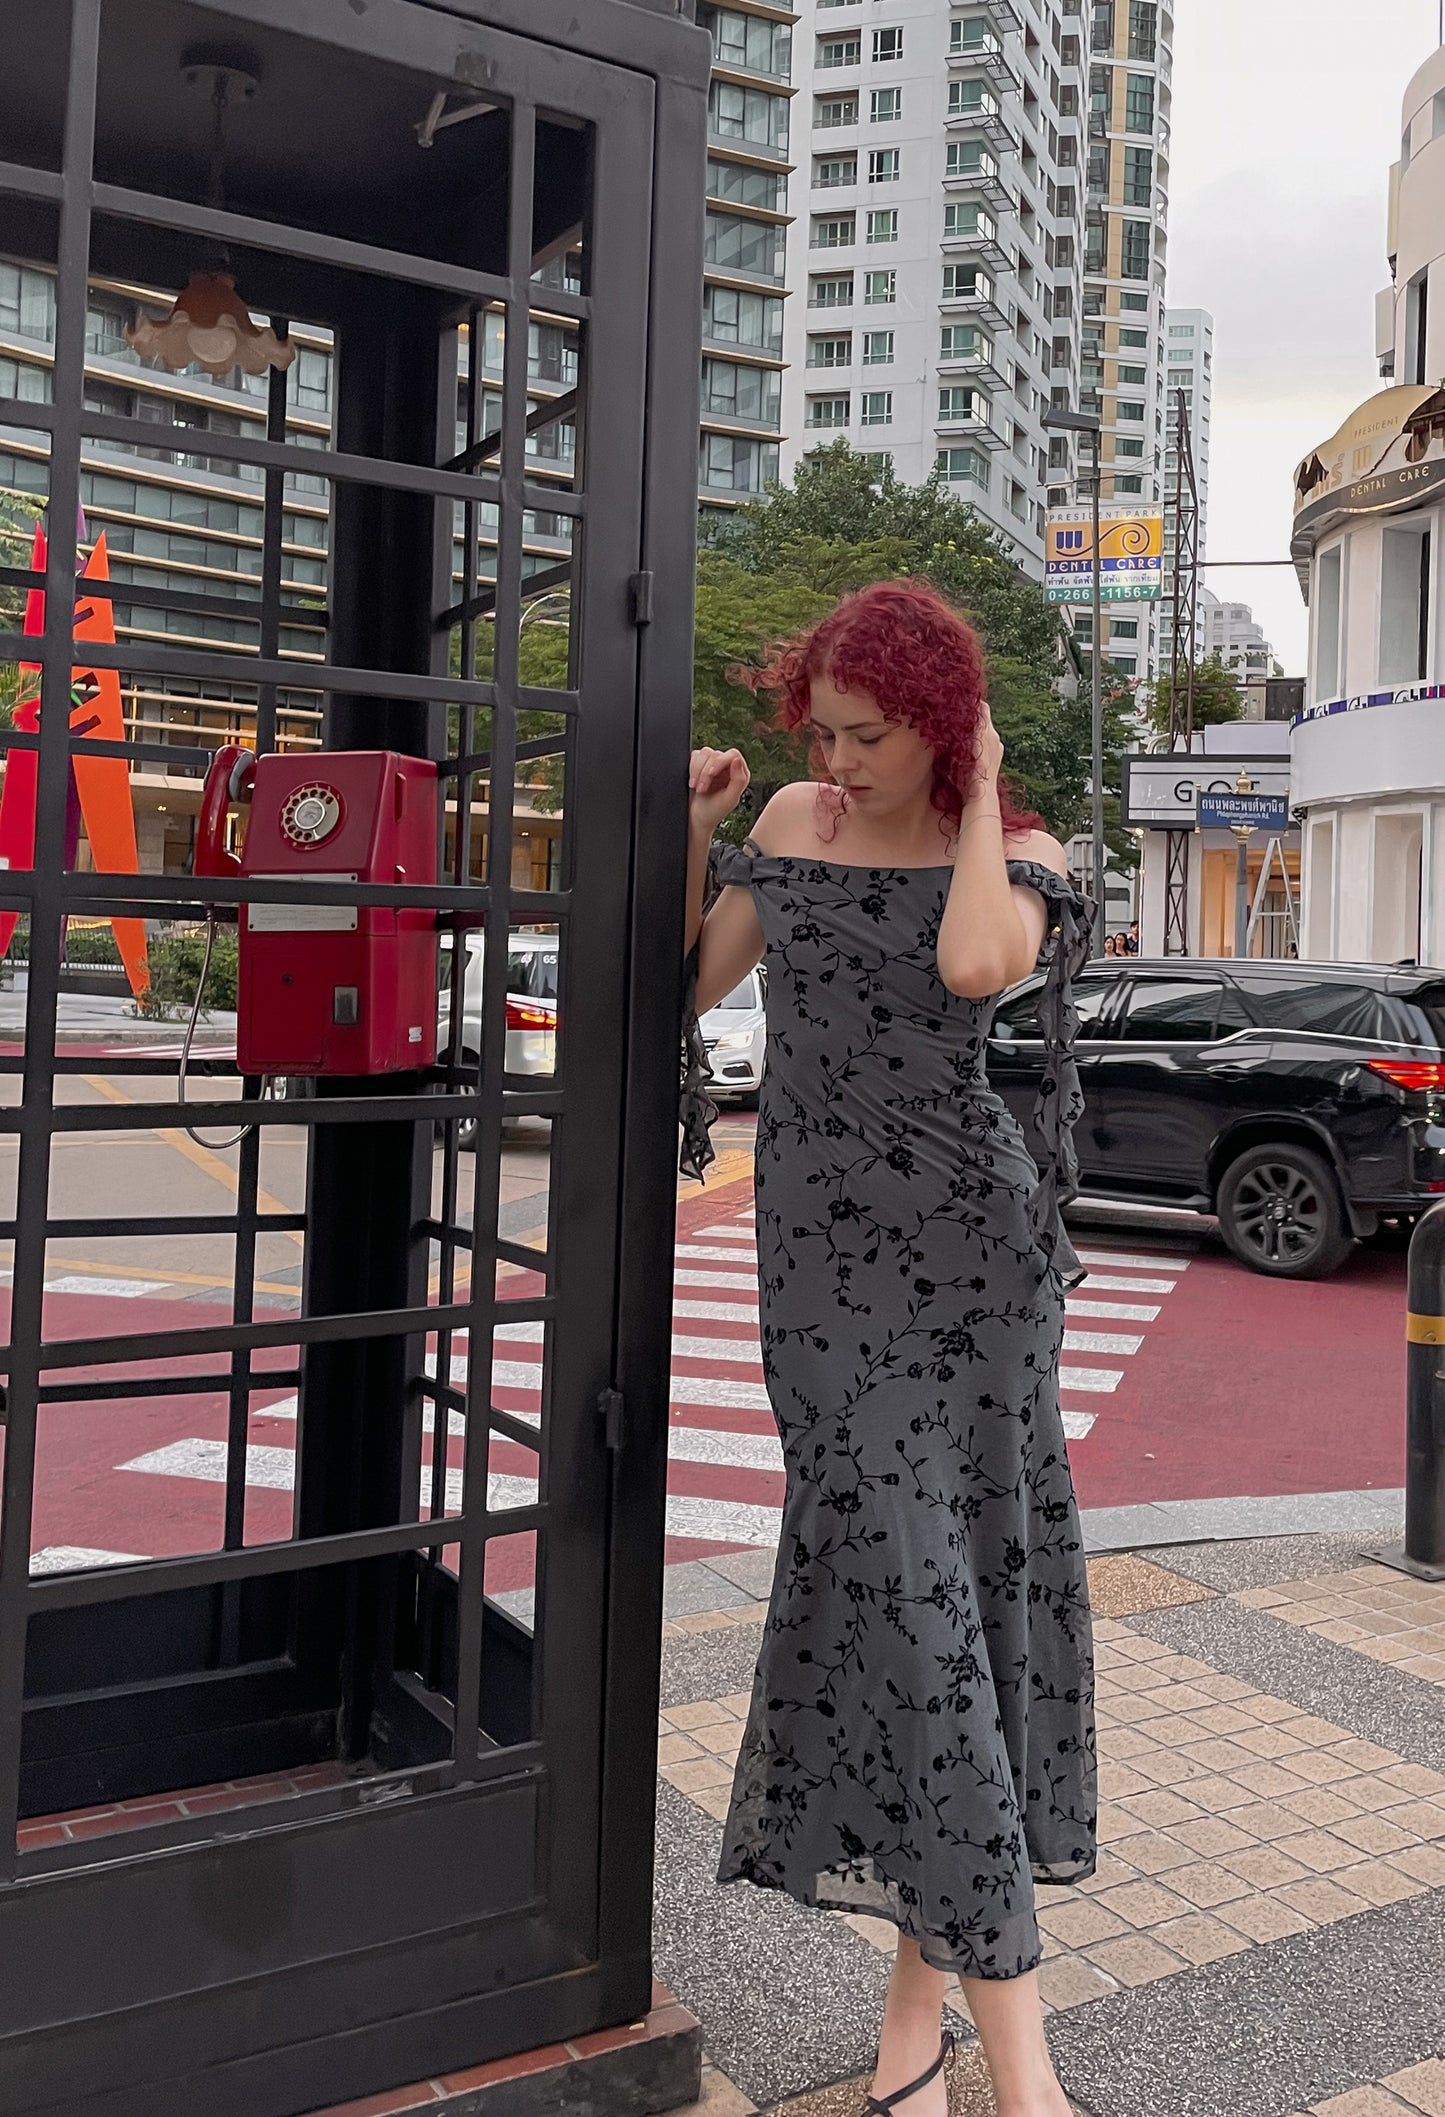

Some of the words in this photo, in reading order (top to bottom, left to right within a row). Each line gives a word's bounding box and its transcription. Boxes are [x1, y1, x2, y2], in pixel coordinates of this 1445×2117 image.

[1350, 478, 1386, 498] DENTAL
[1399, 466, 1430, 482] CARE
[1126, 509, 1157, 518] PARK
[1049, 560, 1106, 572] DENTL
[1116, 557, 1157, 569] CARE
[1048, 586, 1157, 601] 0-266-1156-7
[543, 954, 557, 965] 65
